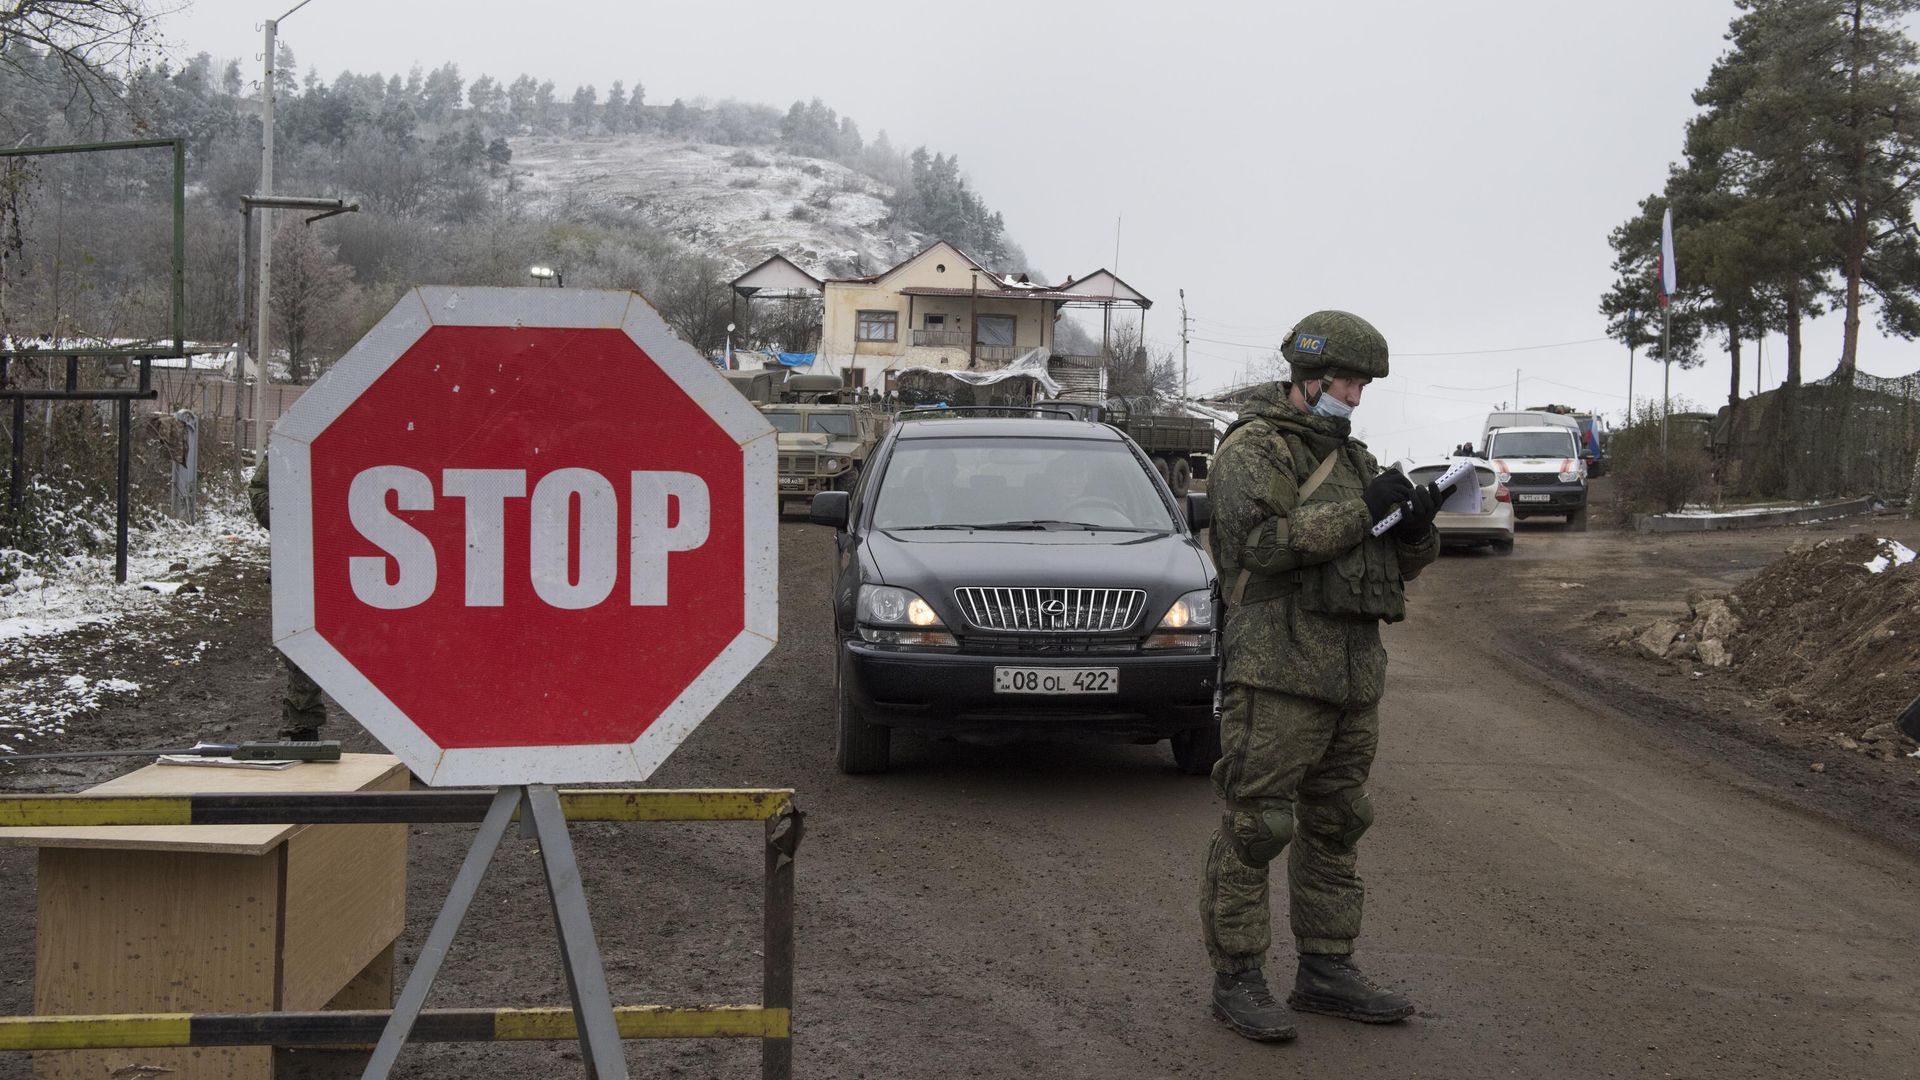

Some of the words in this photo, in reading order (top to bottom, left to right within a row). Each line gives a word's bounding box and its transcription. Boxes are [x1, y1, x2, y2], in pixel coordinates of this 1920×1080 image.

[348, 465, 710, 610] STOP
[1013, 671, 1038, 690] 08
[1043, 676, 1065, 691] OL
[1073, 671, 1109, 691] 422
